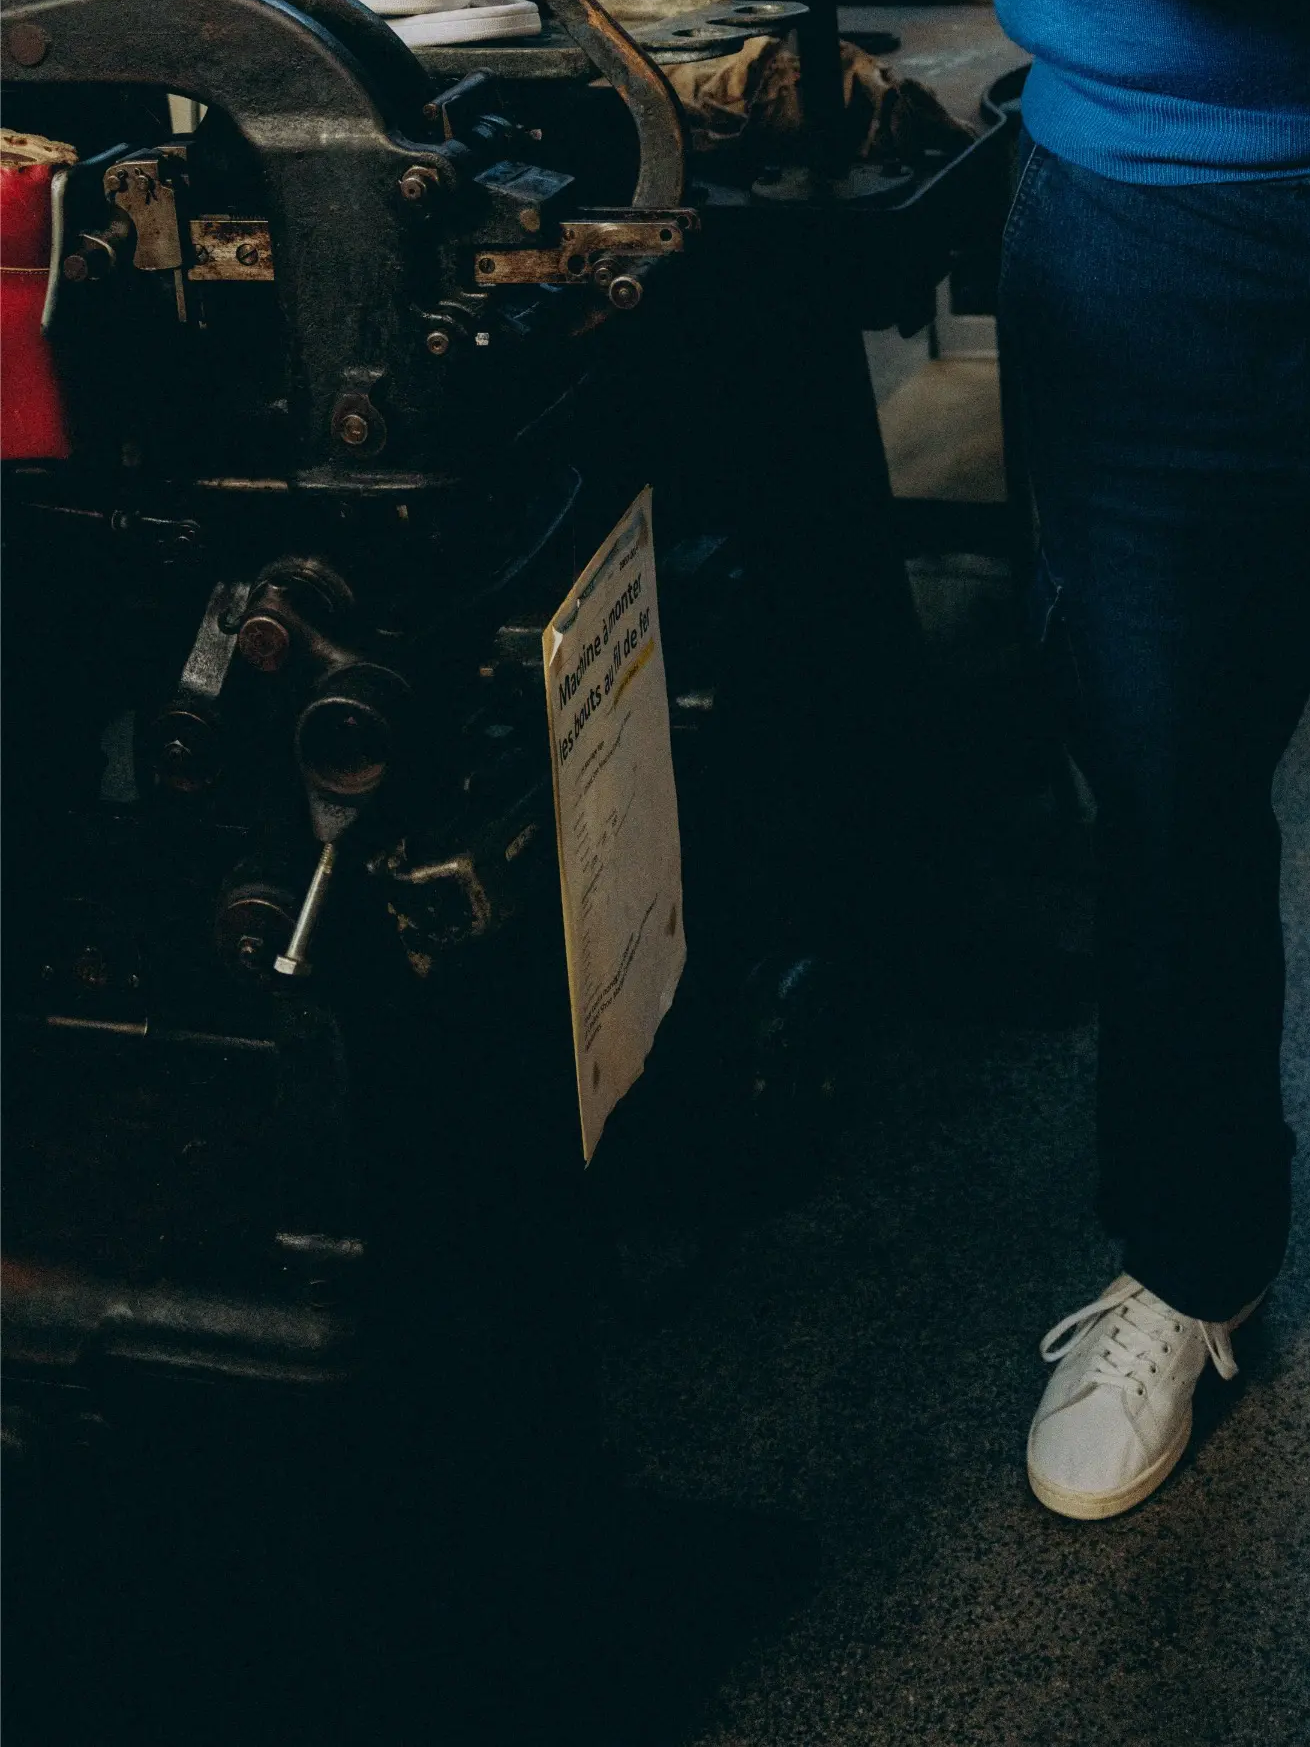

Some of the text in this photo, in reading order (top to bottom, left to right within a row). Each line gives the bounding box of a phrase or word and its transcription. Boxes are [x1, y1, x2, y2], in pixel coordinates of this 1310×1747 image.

[558, 730, 574, 766] les
[574, 684, 602, 739] bouts
[604, 665, 614, 695] au
[613, 640, 622, 674] fil
[623, 628, 638, 658] de
[639, 606, 650, 639] fer
[559, 635, 602, 711] Machine
[602, 618, 609, 645] à
[608, 573, 641, 634] monter
